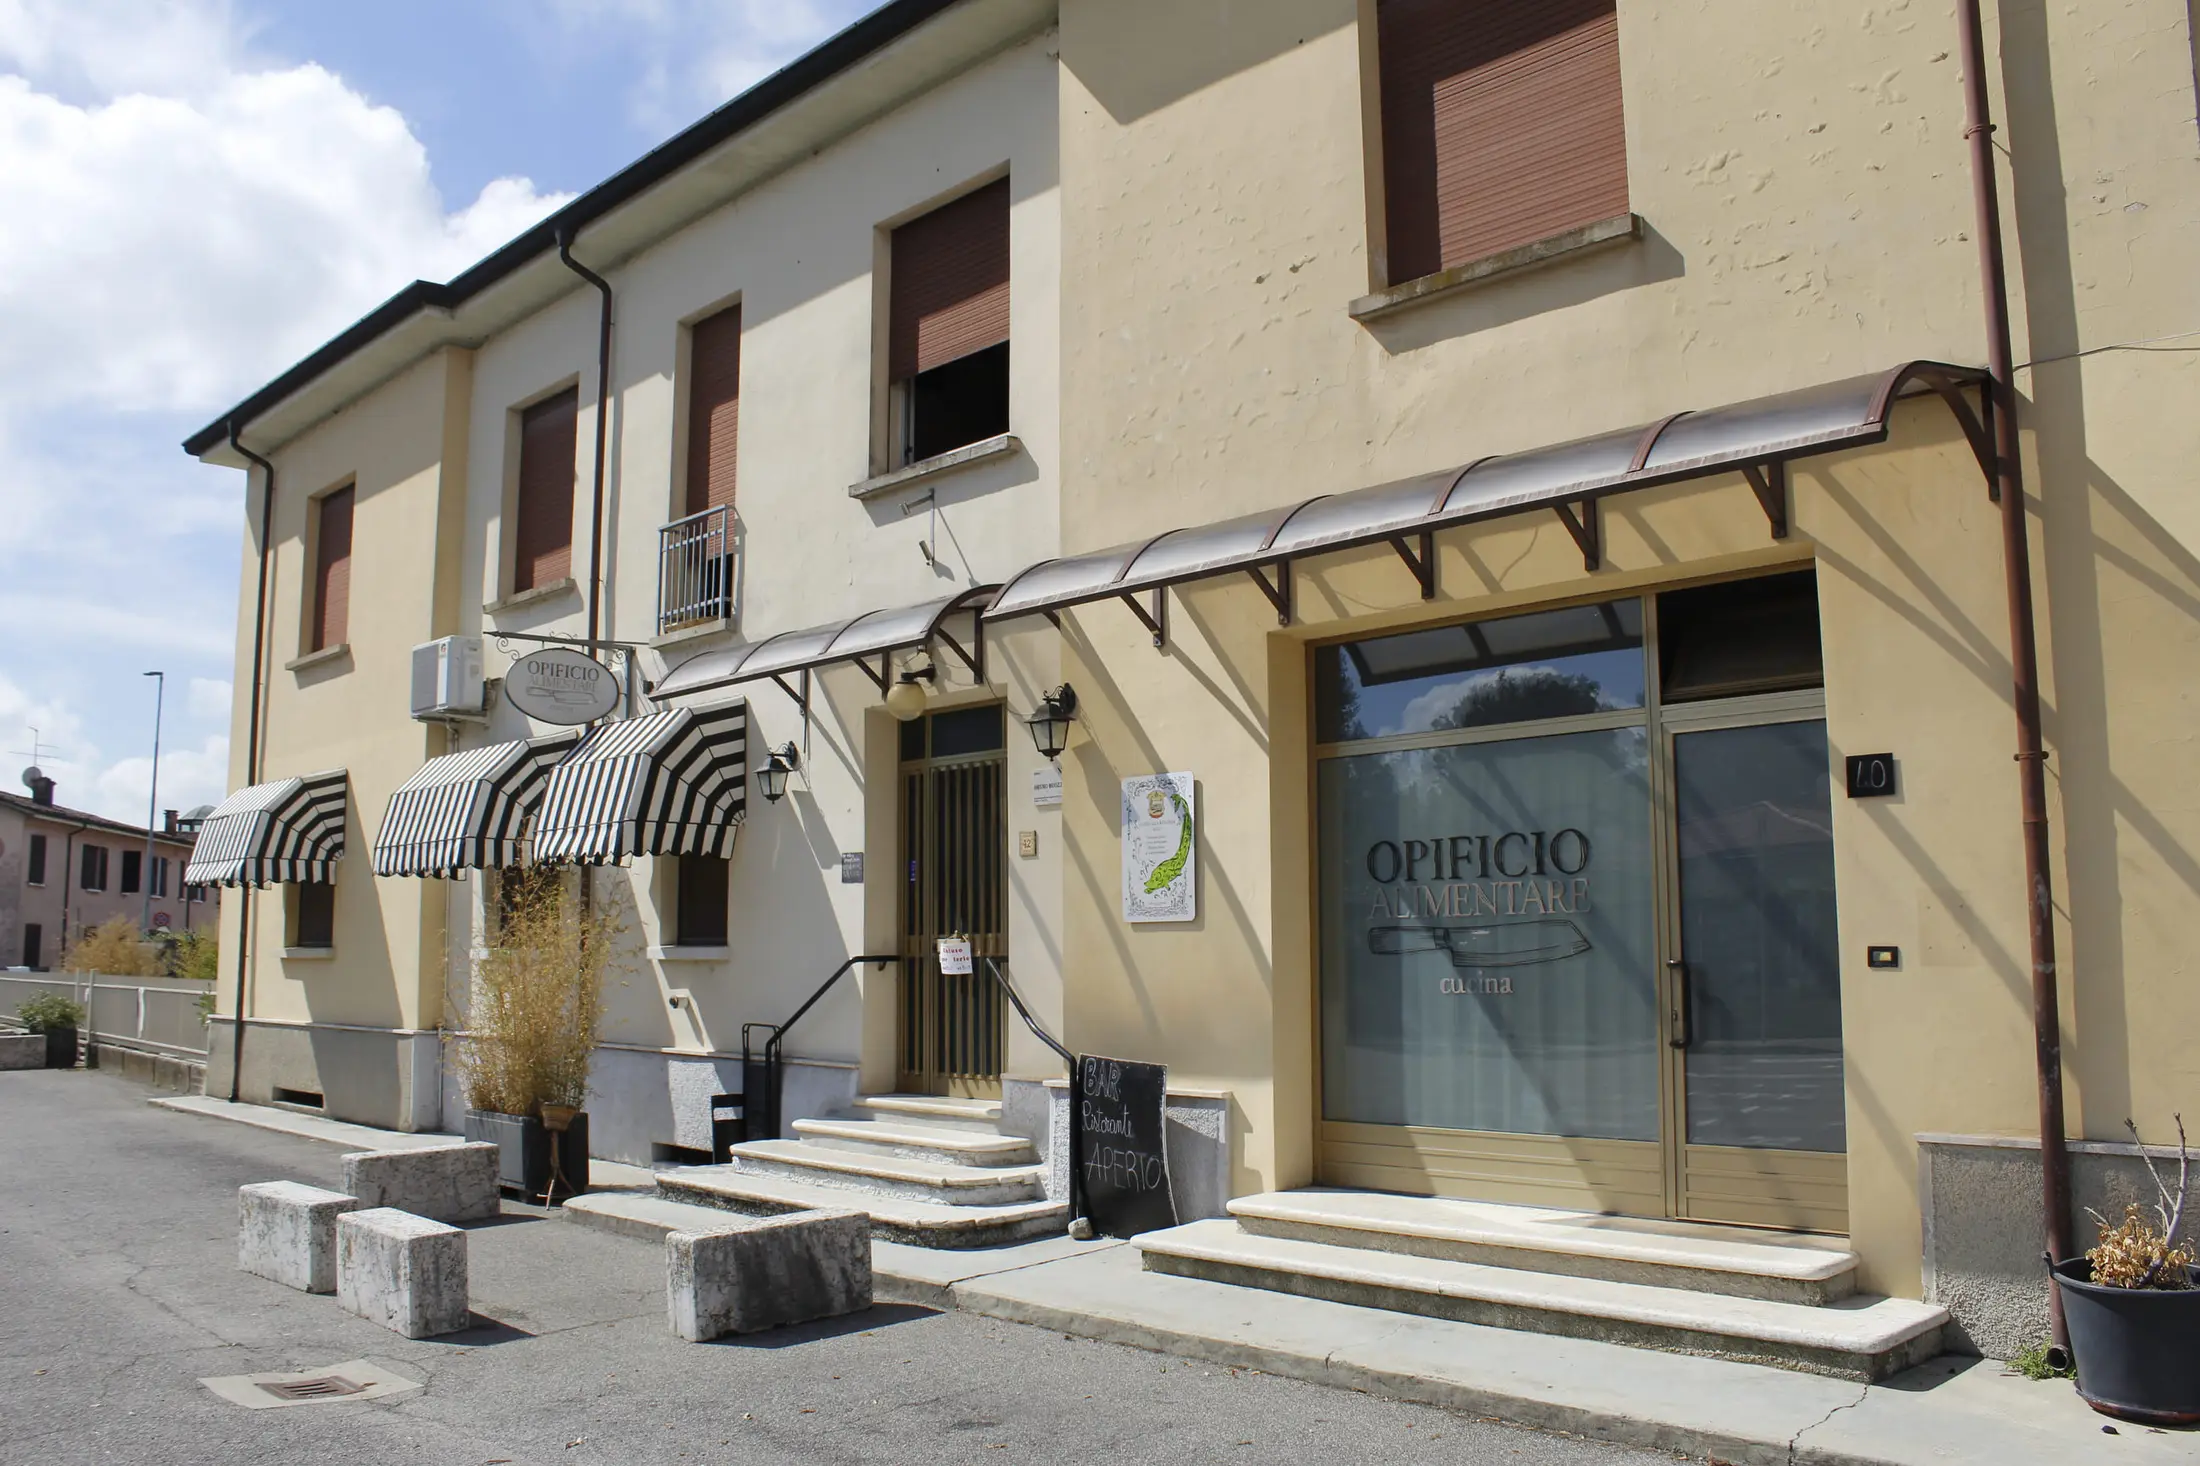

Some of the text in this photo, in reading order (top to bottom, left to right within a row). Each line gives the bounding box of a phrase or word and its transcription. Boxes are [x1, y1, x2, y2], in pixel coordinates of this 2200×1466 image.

[527, 660, 600, 682] OPIFICIO
[1366, 828, 1590, 884] OPIFICIO
[1367, 877, 1592, 920] ALIMENTARE
[1439, 970, 1514, 995] cucina
[1083, 1057, 1122, 1102] BAR
[1082, 1101, 1135, 1139] Ristorante
[1084, 1142, 1162, 1193] APERTO
